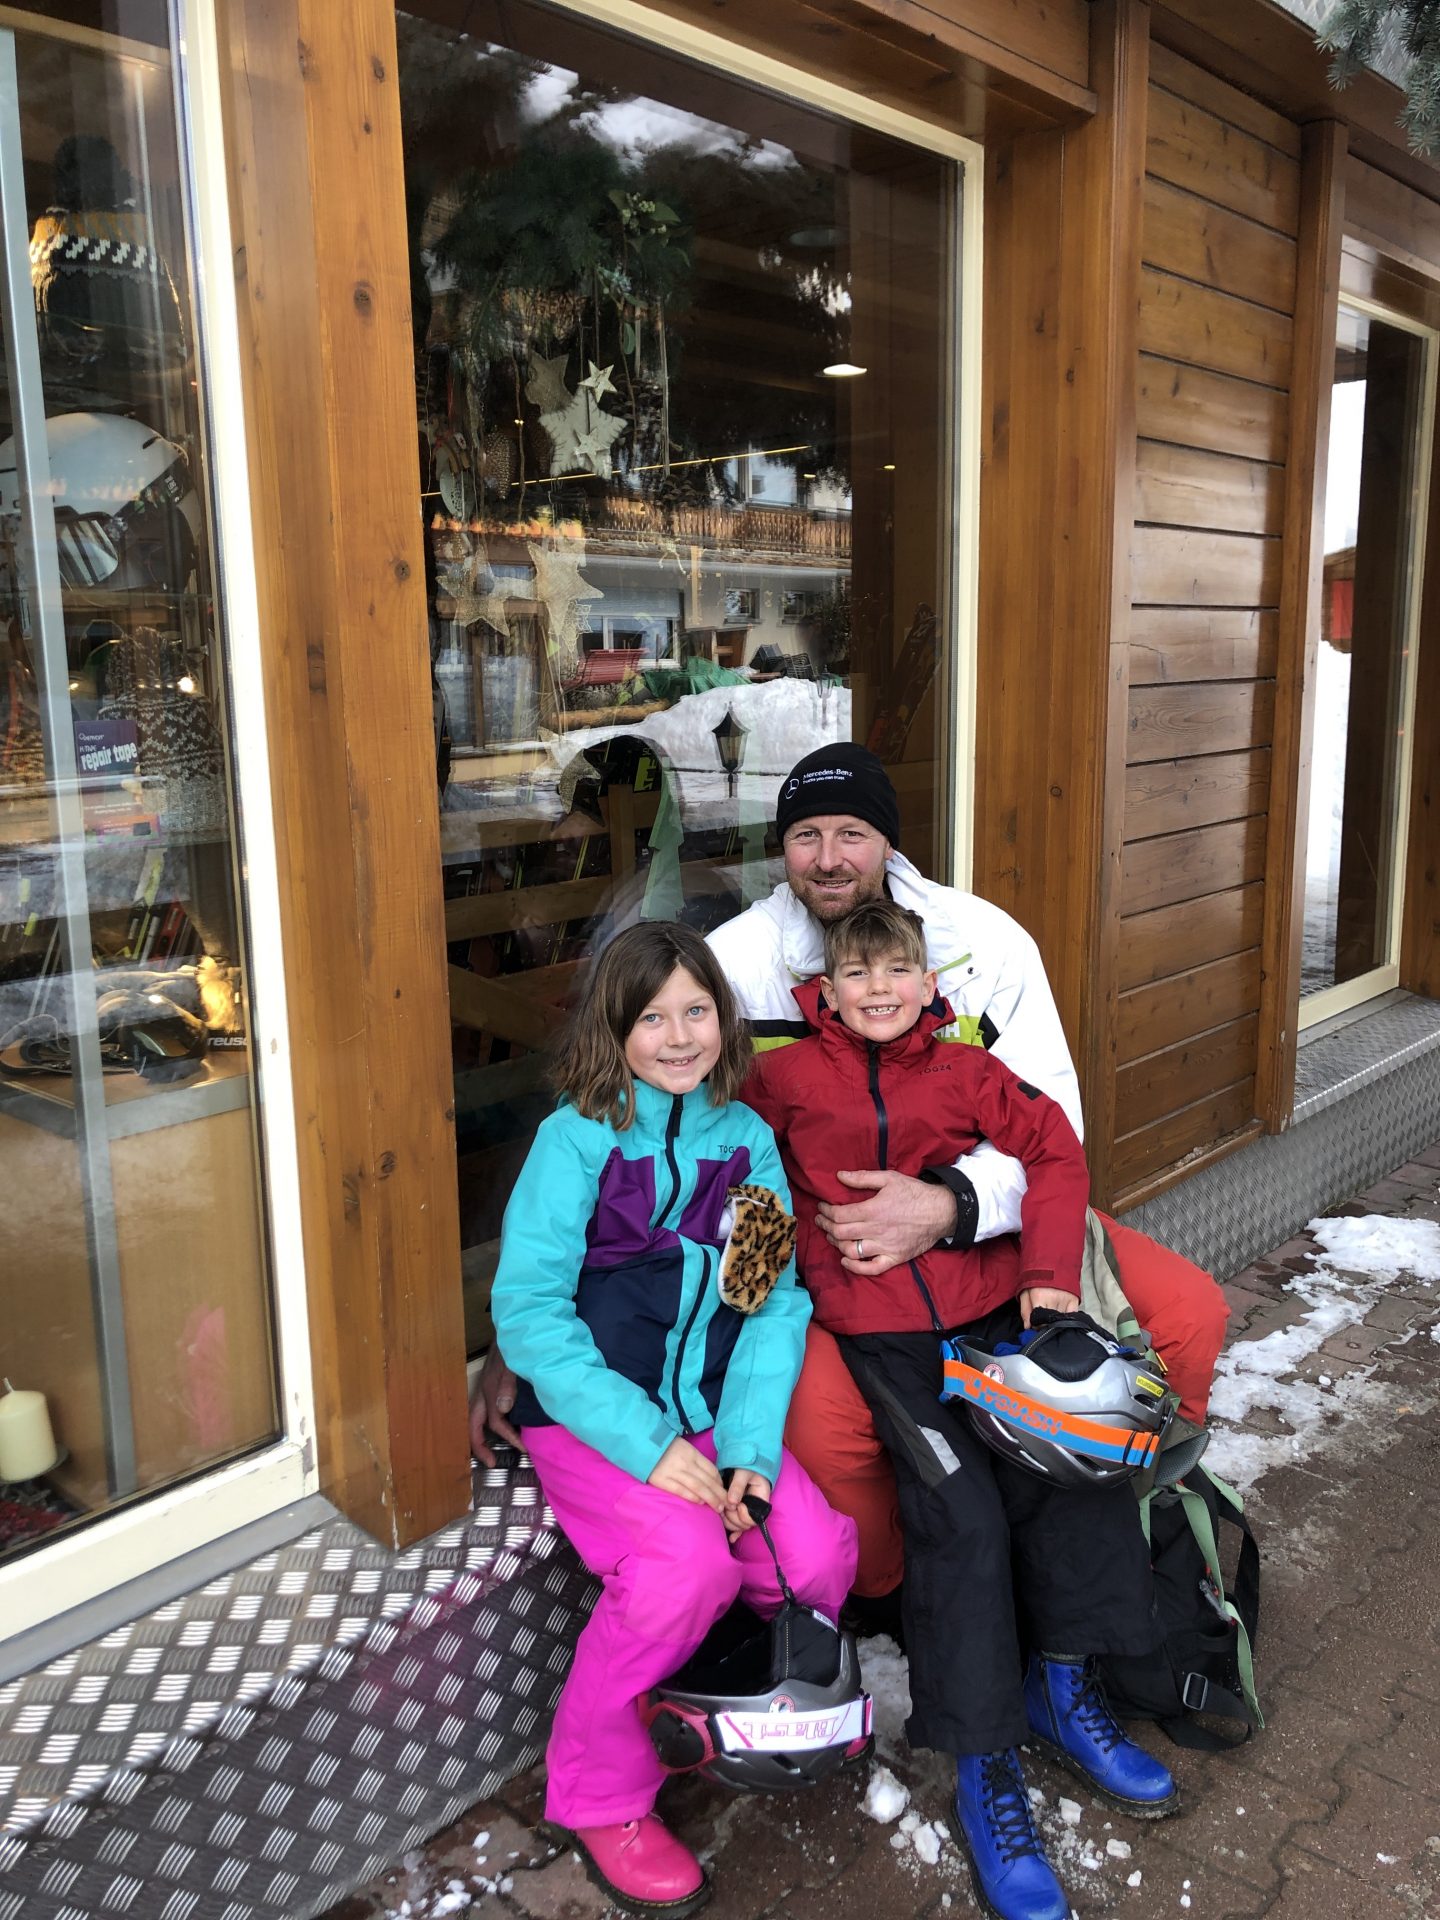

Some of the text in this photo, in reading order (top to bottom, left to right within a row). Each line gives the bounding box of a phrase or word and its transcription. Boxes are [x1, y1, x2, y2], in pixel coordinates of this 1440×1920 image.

[80, 742, 138, 771] repair tape
[803, 768, 853, 780] Mercedes-Benz
[918, 1064, 952, 1075] TOG24
[717, 1144, 736, 1154] TOG
[983, 1387, 1063, 1436] NEVICA
